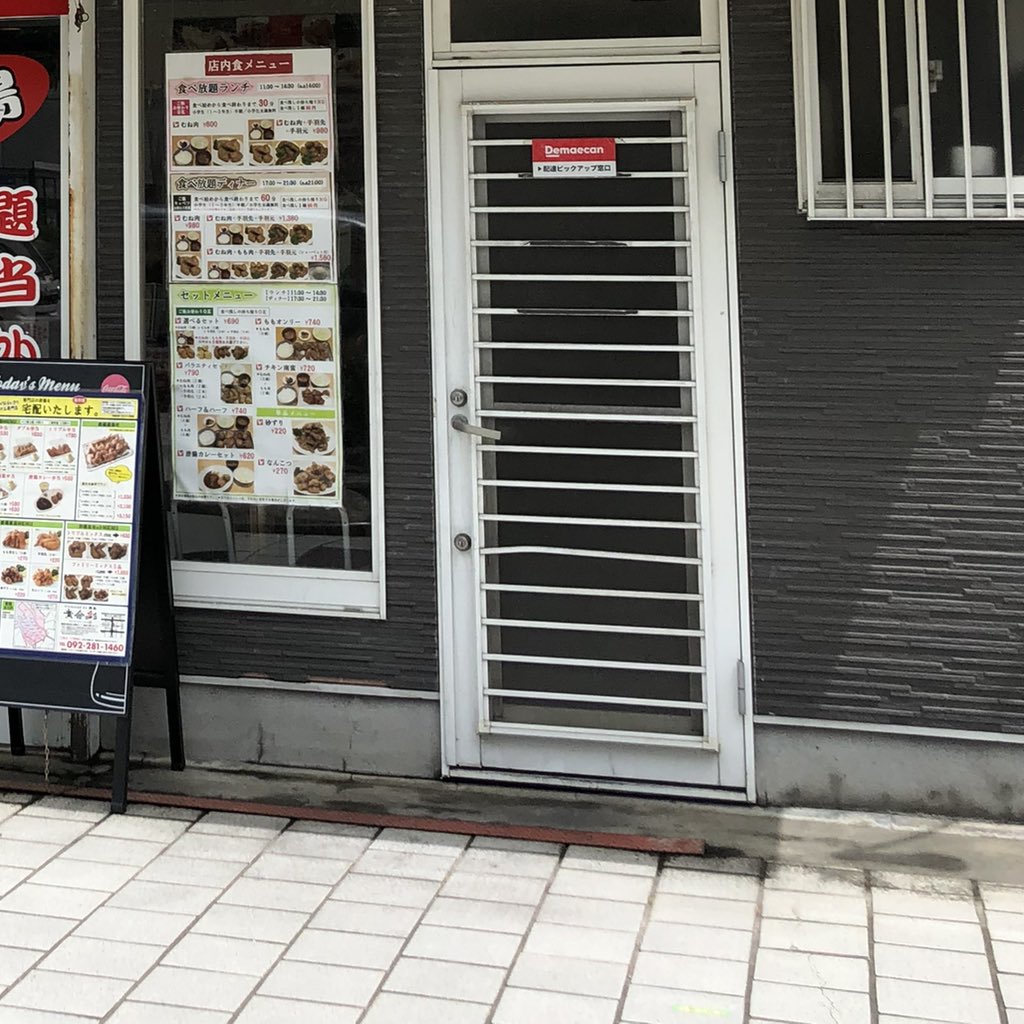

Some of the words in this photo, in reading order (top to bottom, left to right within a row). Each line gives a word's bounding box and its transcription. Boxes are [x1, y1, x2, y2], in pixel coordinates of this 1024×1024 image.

[208, 58, 290, 72] 店内食メニュー
[178, 82, 251, 94] 食べ放題ランチ
[544, 145, 604, 155] Demaecan
[180, 291, 253, 300] セットメニュー
[38, 376, 81, 392] Menu
[21, 403, 98, 416] 宅配いたします。
[67, 641, 124, 652] 092-281-1460
